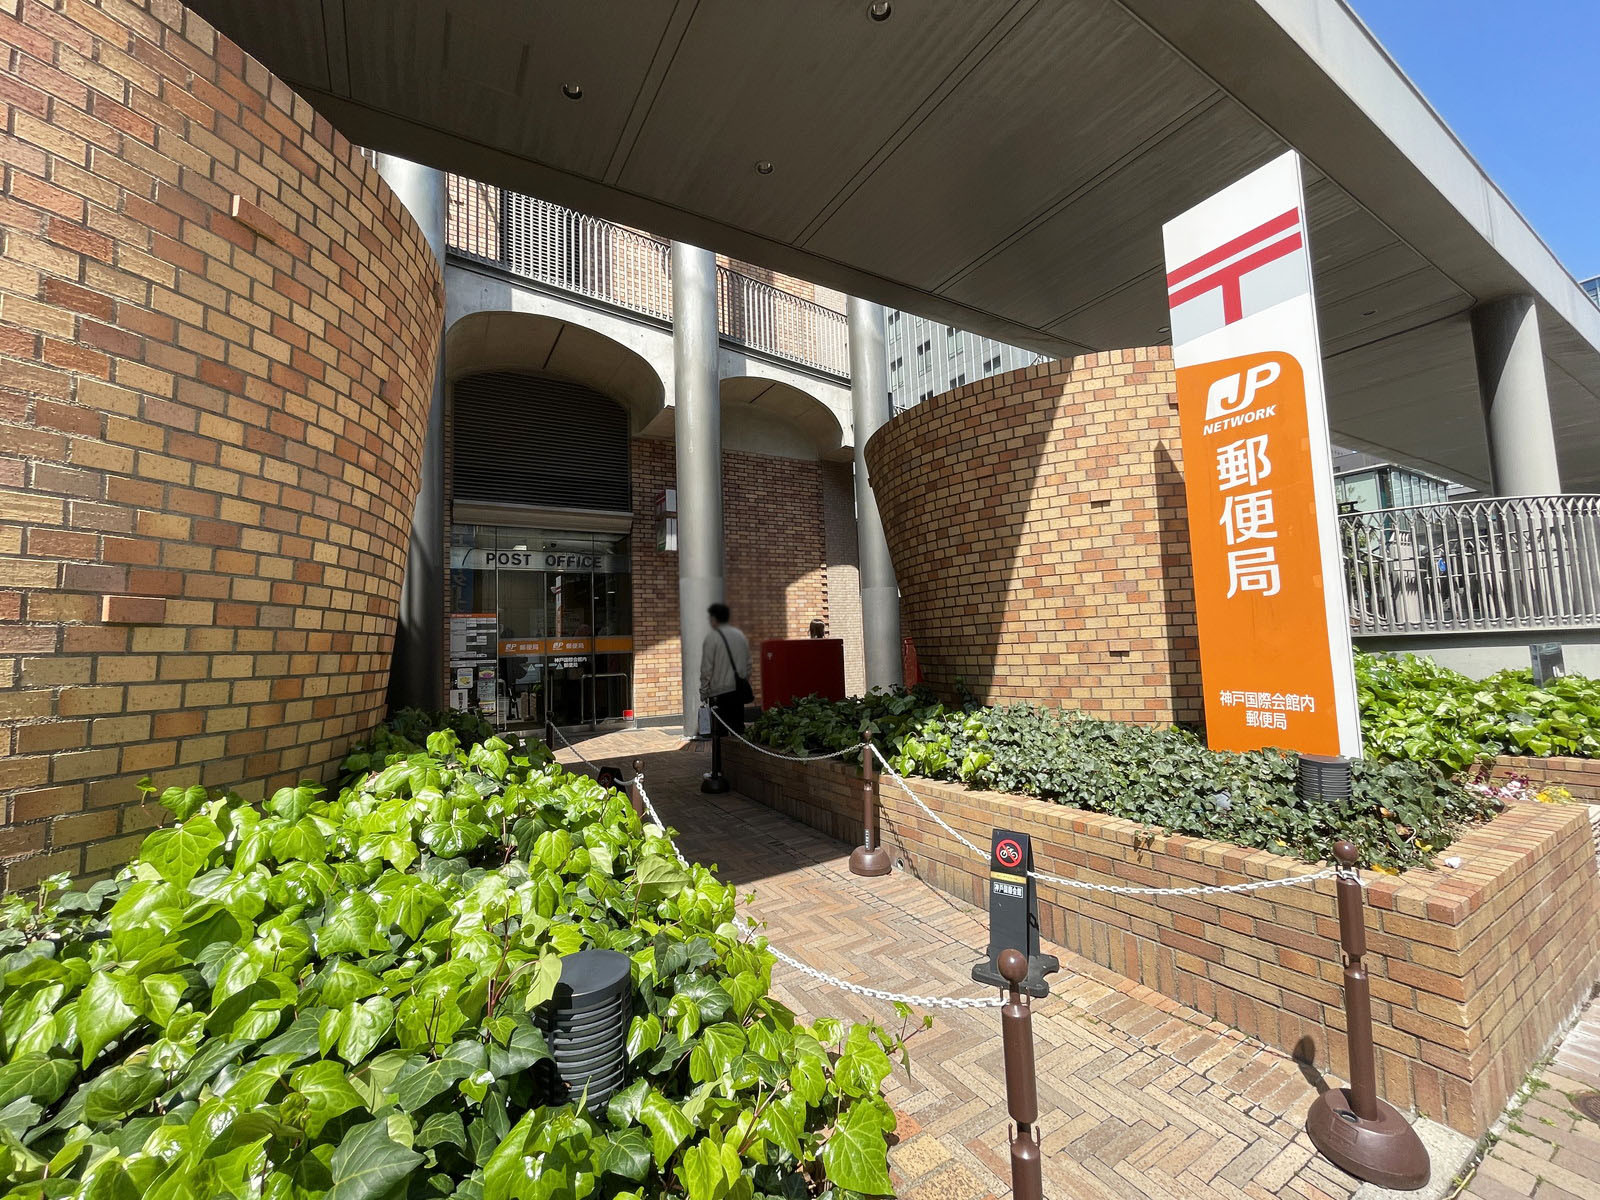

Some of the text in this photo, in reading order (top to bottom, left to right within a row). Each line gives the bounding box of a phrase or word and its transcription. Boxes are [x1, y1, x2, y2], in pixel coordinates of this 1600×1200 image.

[1203, 404, 1277, 436] NETWORK
[1216, 434, 1281, 600] 郵便局
[486, 552, 603, 569] POST OFFICE
[1219, 690, 1316, 713] 神戸国際会館内
[1246, 710, 1288, 731] 郵便局
